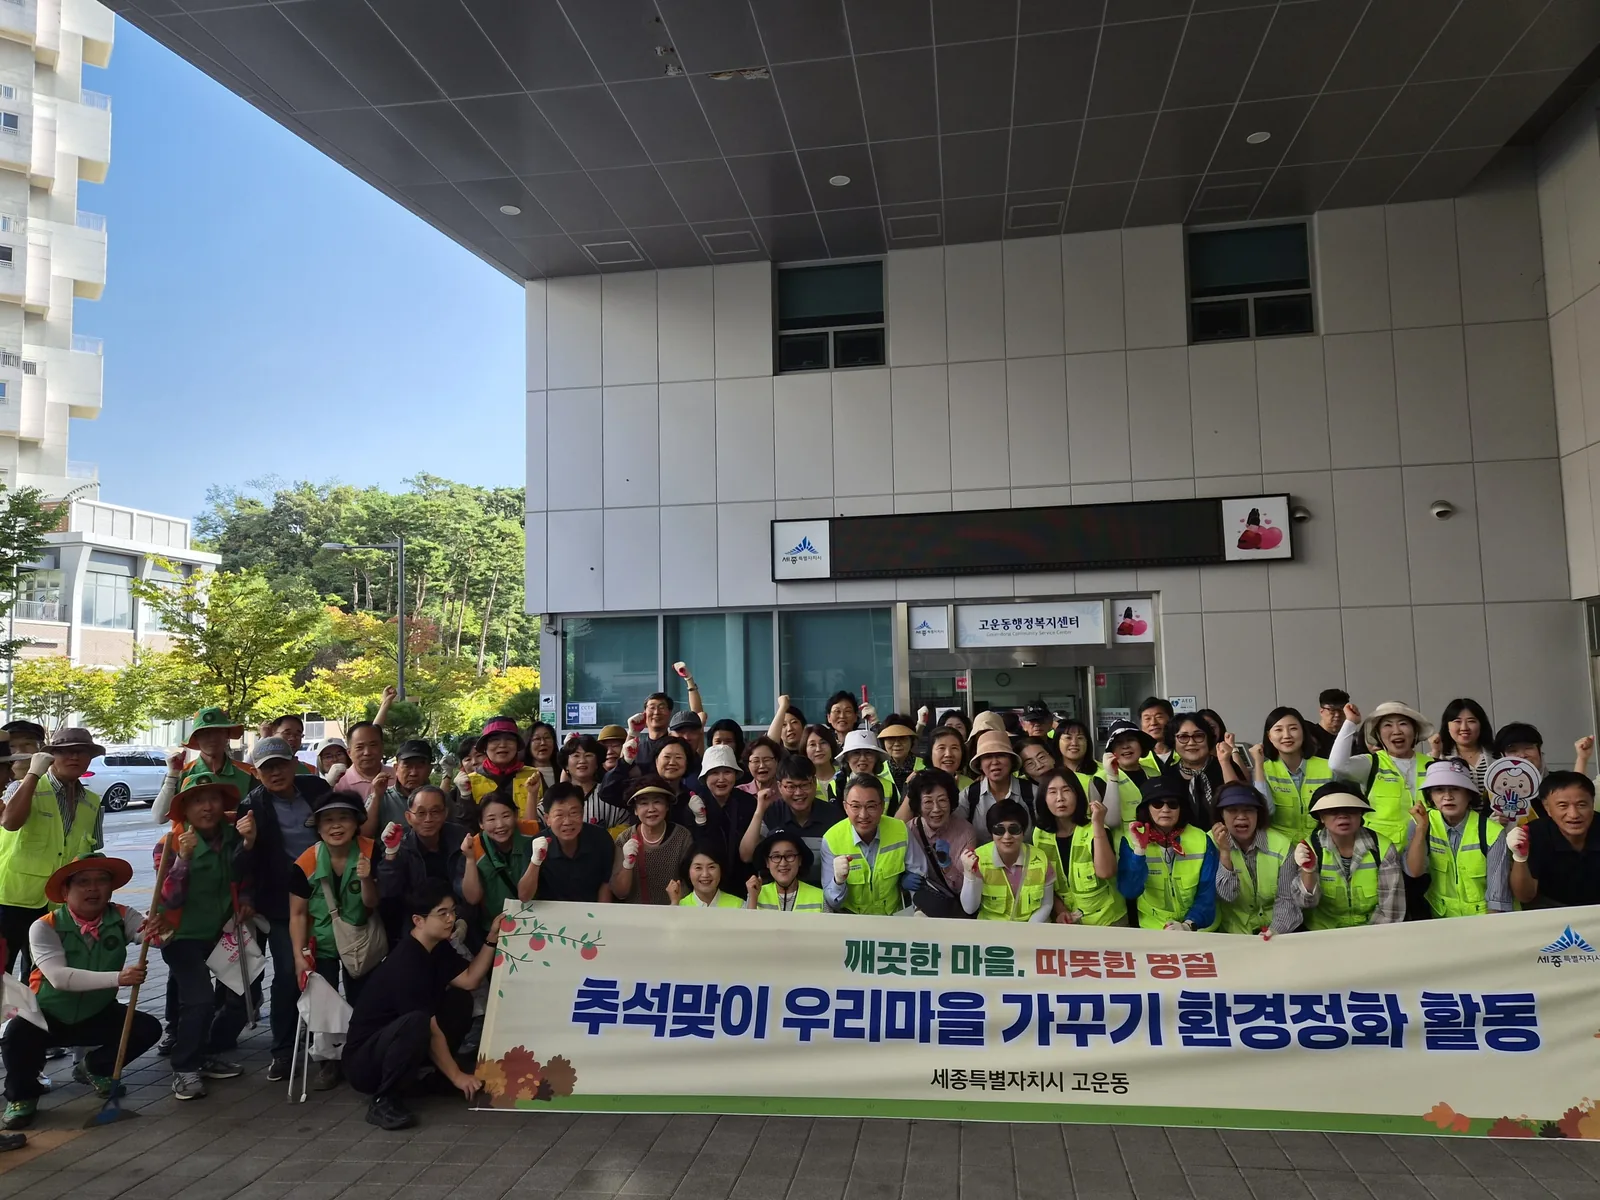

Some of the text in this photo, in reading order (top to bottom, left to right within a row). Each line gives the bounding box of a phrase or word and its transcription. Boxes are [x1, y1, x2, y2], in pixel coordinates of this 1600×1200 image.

[978, 616, 1080, 631] 고운동행정복지센터
[844, 939, 942, 977] 깨끗한
[1035, 948, 1137, 979] 따뜻한
[1146, 952, 1218, 980] 명절
[571, 977, 1541, 1052] 추석맞이 우리마을 가꾸기 환경정화 활동
[930, 1068, 1130, 1094] 세종특별자치시 고운동
